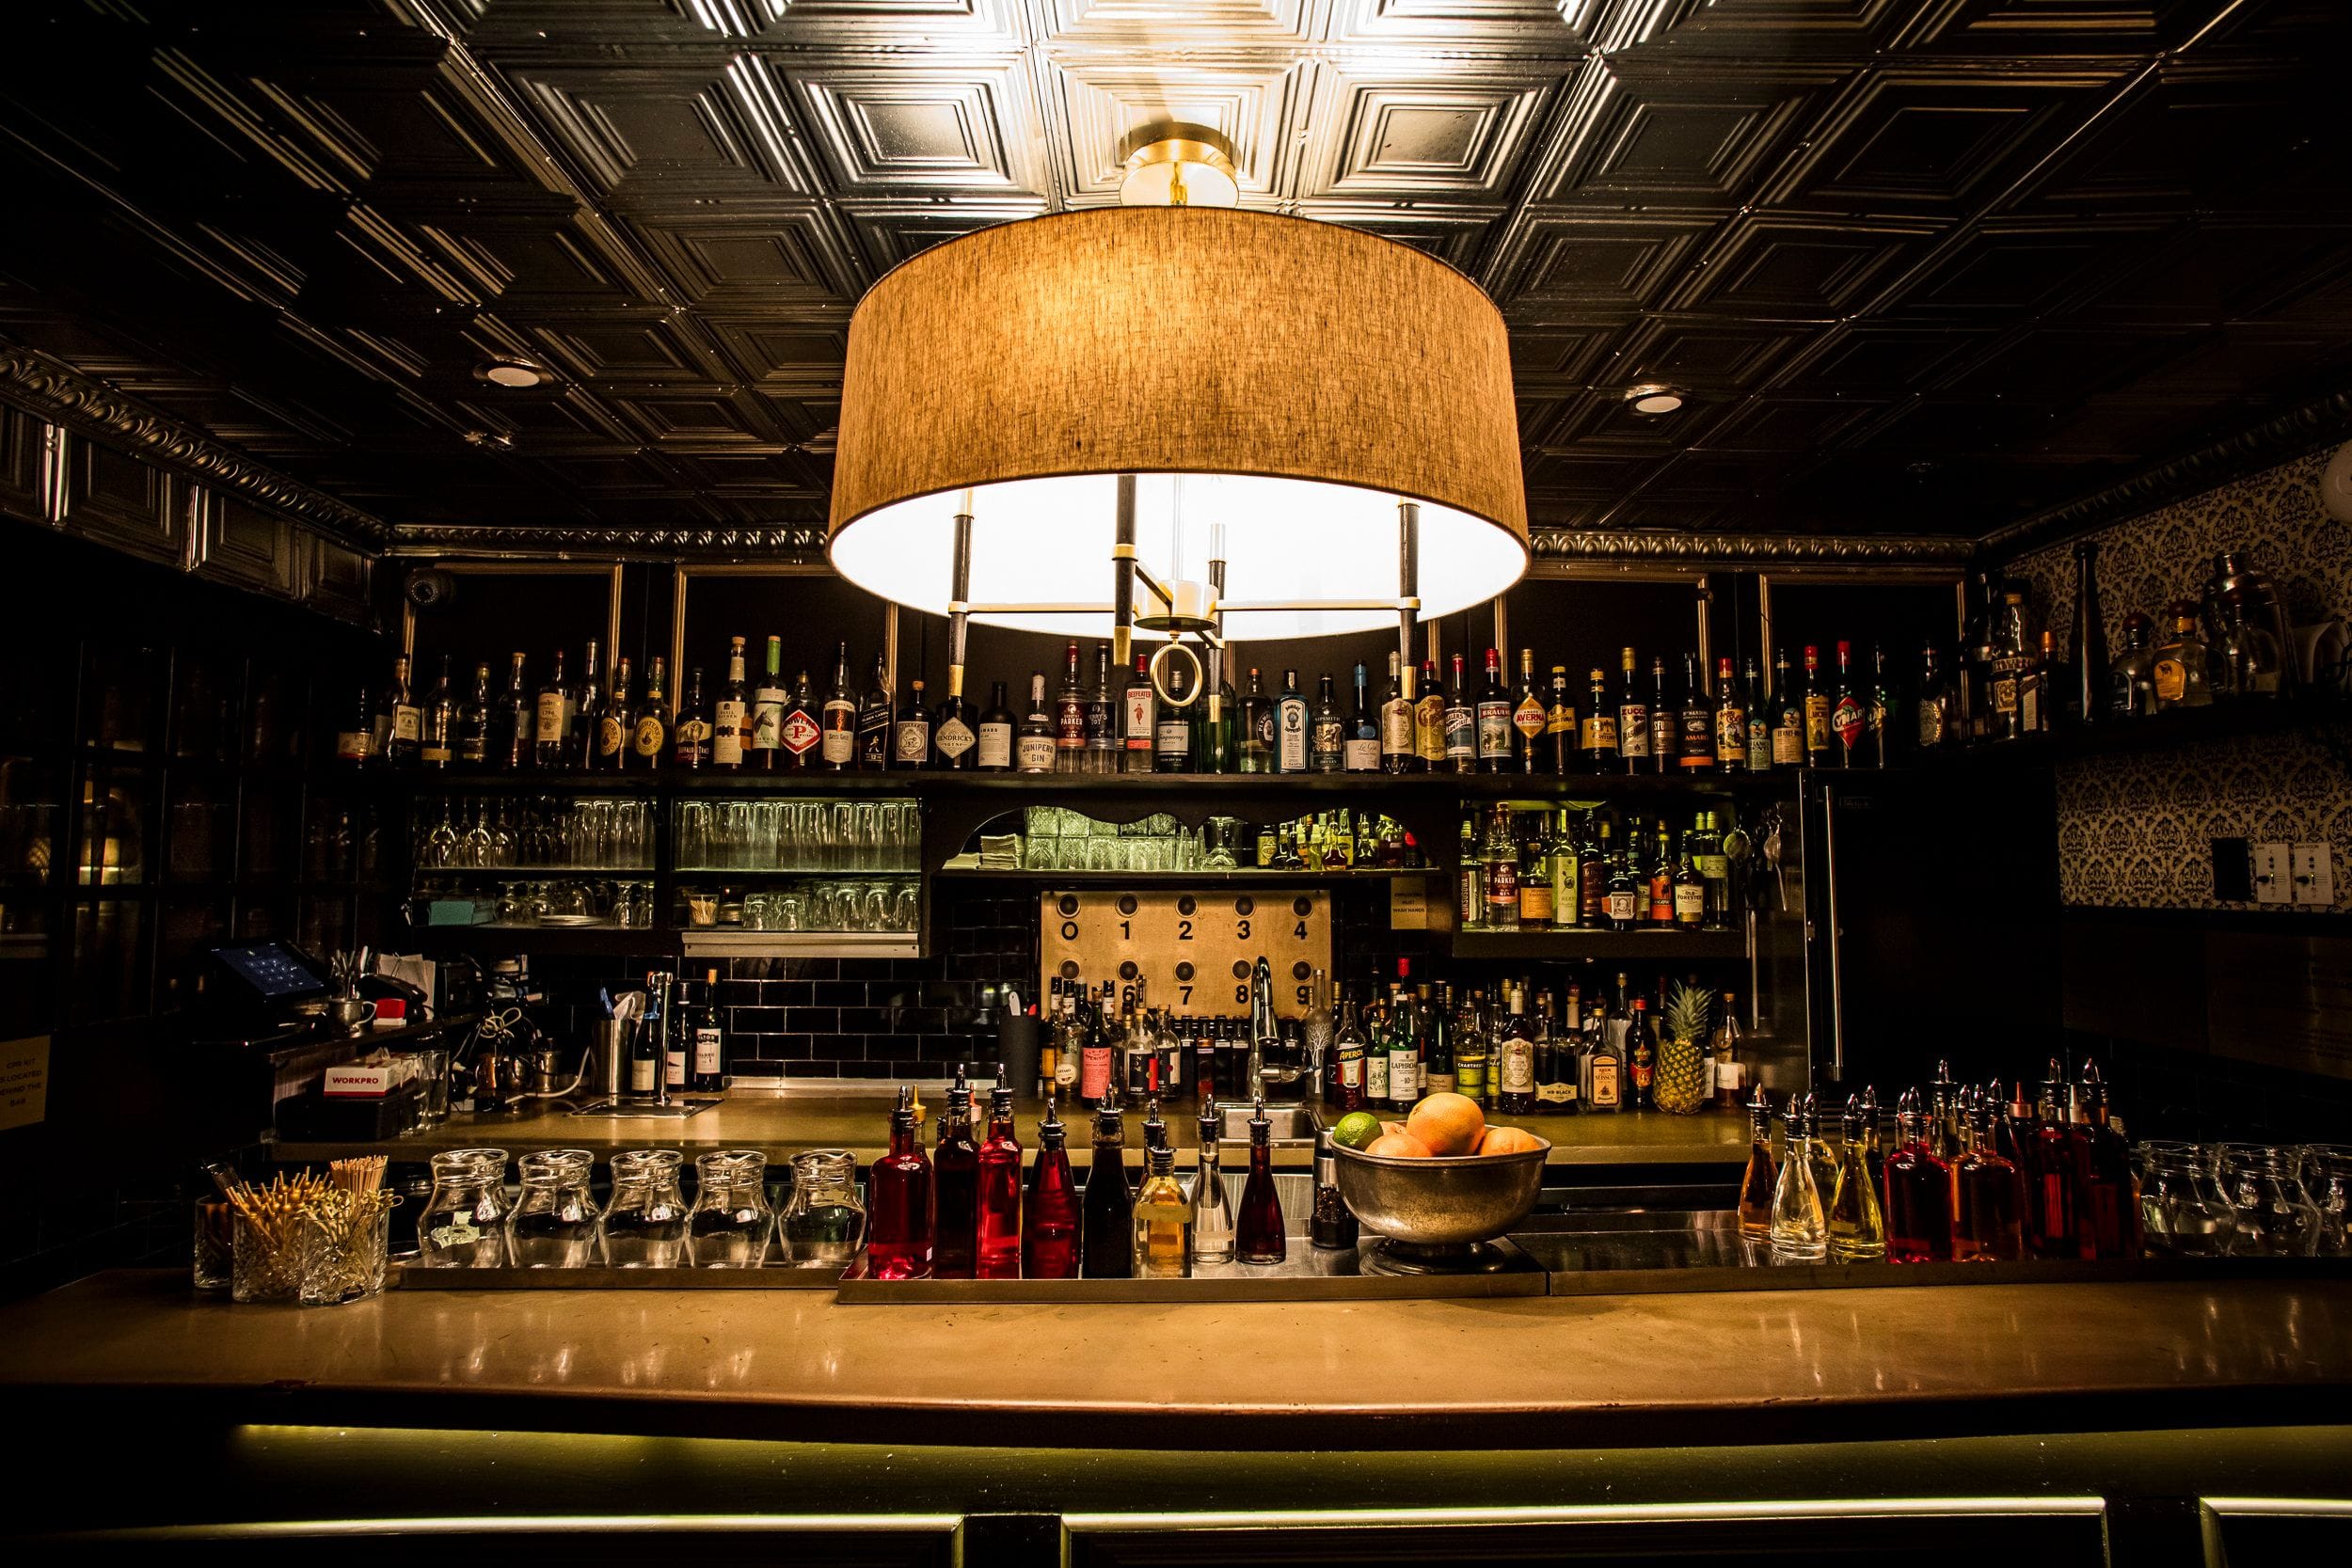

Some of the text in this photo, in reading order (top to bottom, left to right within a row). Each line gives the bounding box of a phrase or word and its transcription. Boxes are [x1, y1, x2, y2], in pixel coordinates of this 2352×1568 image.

[1517, 713, 1545, 723] AVERNA
[1061, 921, 1308, 940] 0 1 2 3 4
[1122, 985, 1309, 1006] 6 7 8 9
